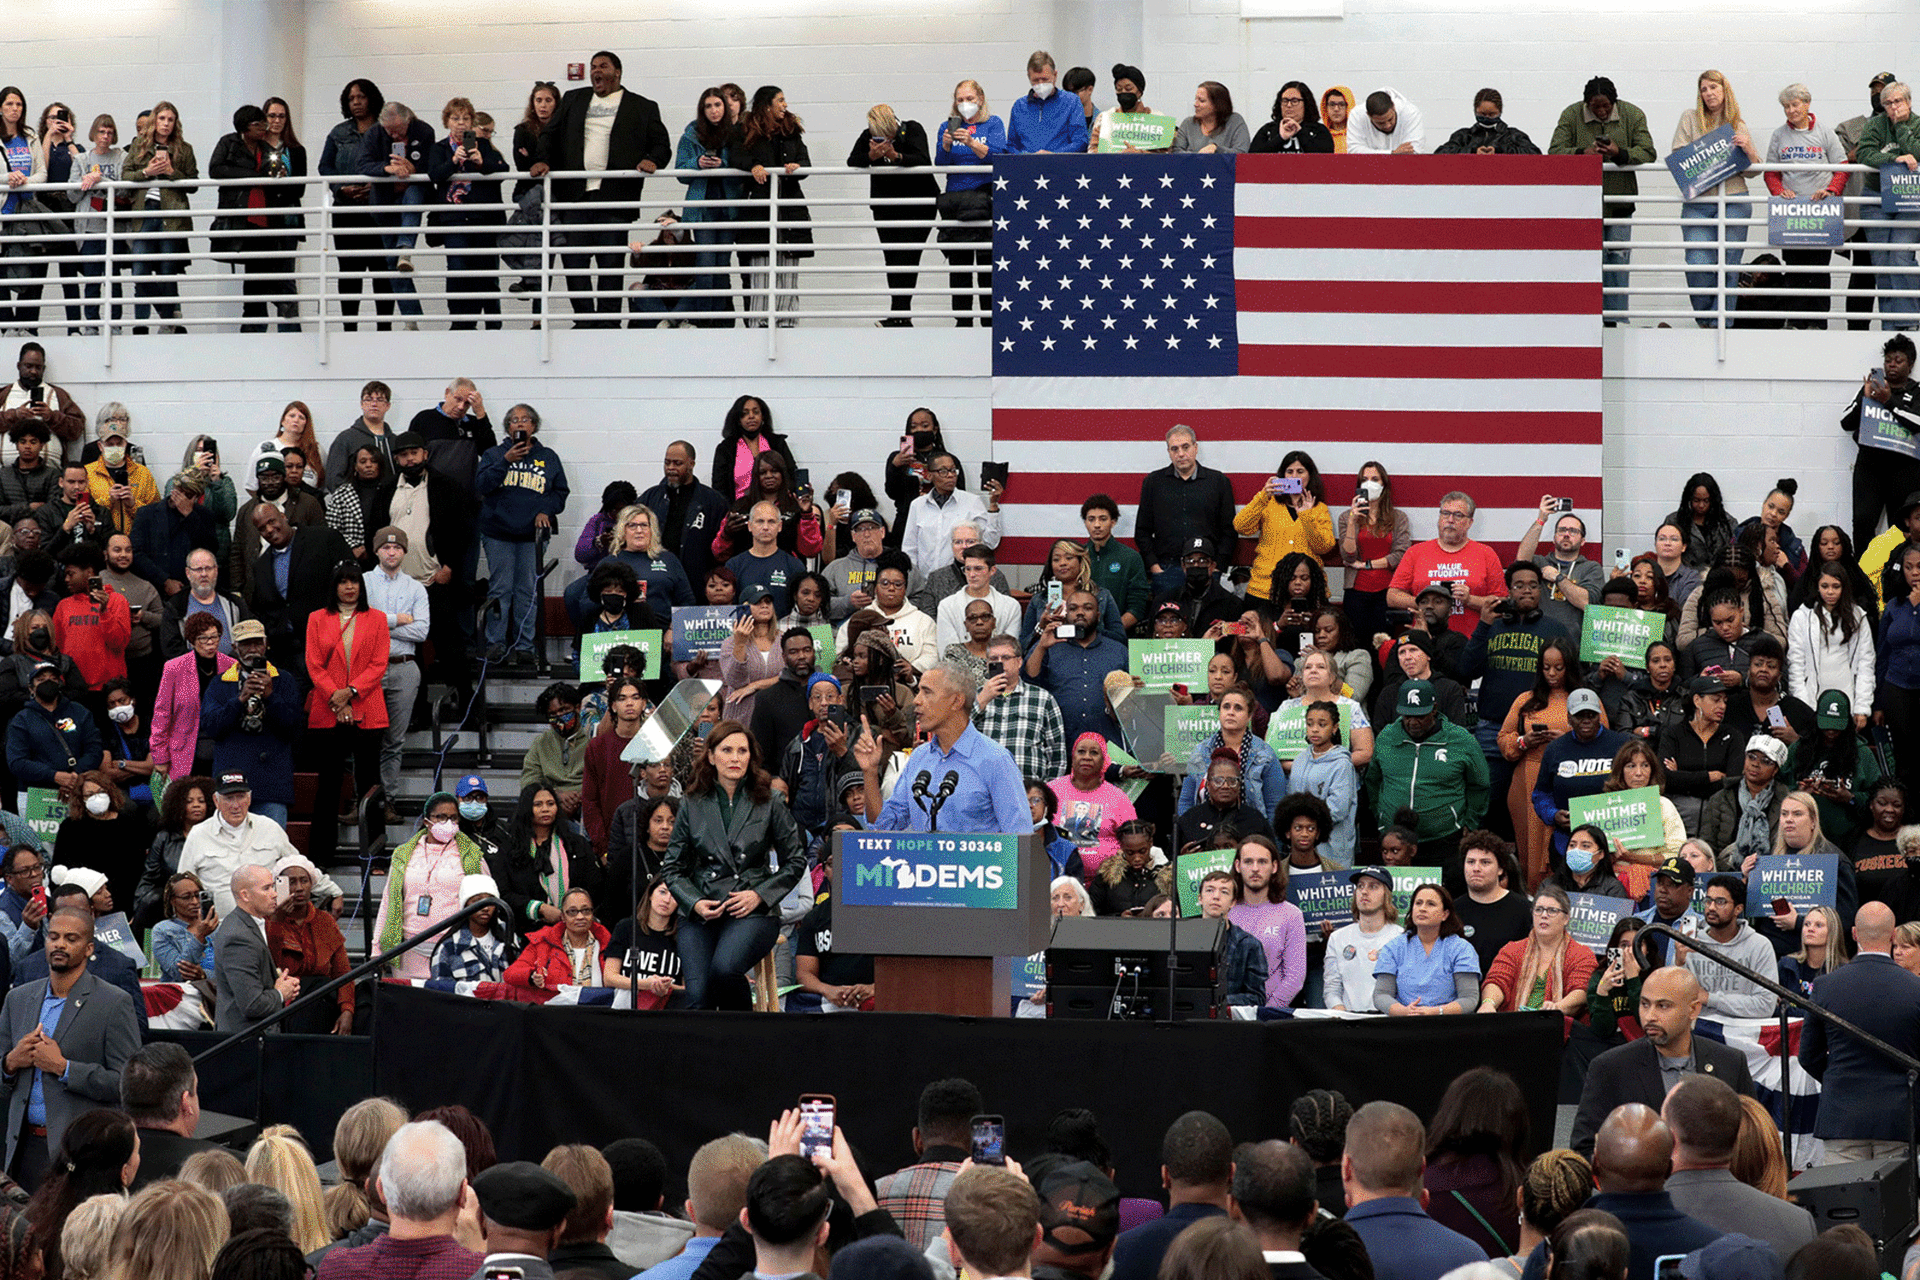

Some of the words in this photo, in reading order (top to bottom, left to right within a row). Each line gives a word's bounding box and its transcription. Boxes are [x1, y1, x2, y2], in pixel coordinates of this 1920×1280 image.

[1112, 122, 1164, 135] WHITMER
[1111, 130, 1162, 142] GILCHRIST
[1678, 138, 1729, 171] WHITMER
[87, 163, 115, 173] LVE
[1891, 174, 1920, 184] WHIT
[1891, 185, 1920, 195] GILCH
[1771, 204, 1840, 216] MICHIGAN
[1787, 218, 1825, 230] FIRST
[1428, 569, 1469, 578] STUDENTS
[1437, 563, 1462, 571] VALUE
[684, 619, 734, 631] WHITME
[1593, 619, 1650, 637] WHITMER
[684, 629, 731, 641] GILCHRI
[1592, 630, 1649, 647] GILCHRIST
[1488, 632, 1544, 654] MICHIGA
[1142, 652, 1202, 663] WHITMER
[1142, 662, 1201, 675] GILCHRIST
[1488, 656, 1538, 673] WOLVERINE
[1178, 719, 1221, 731] WHITM
[1279, 718, 1306, 731] WHIT
[1278, 729, 1306, 741] GILCH
[1578, 758, 1613, 773] VOTE
[1583, 802, 1647, 822] WHITMER
[1588, 814, 1647, 832] ILCHRIST
[858, 839, 892, 850] TEXT
[896, 840, 933, 851] HOPE
[937, 840, 955, 851] TO
[959, 840, 1003, 852] 30348
[856, 863, 893, 887] MI
[915, 864, 1004, 889] DEMS
[1761, 869, 1824, 882] WHITMER
[1297, 884, 1356, 900] WHITME
[1760, 882, 1823, 895] GILCHRIST
[1299, 897, 1354, 913] GILCHRI
[1570, 906, 1617, 924] ITMER
[1264, 926, 1280, 936] AE
[1568, 919, 1615, 935] CHRIST
[623, 948, 659, 972] LVE
[1692, 956, 1752, 976] MICHAN
[1702, 975, 1739, 993] STATE
